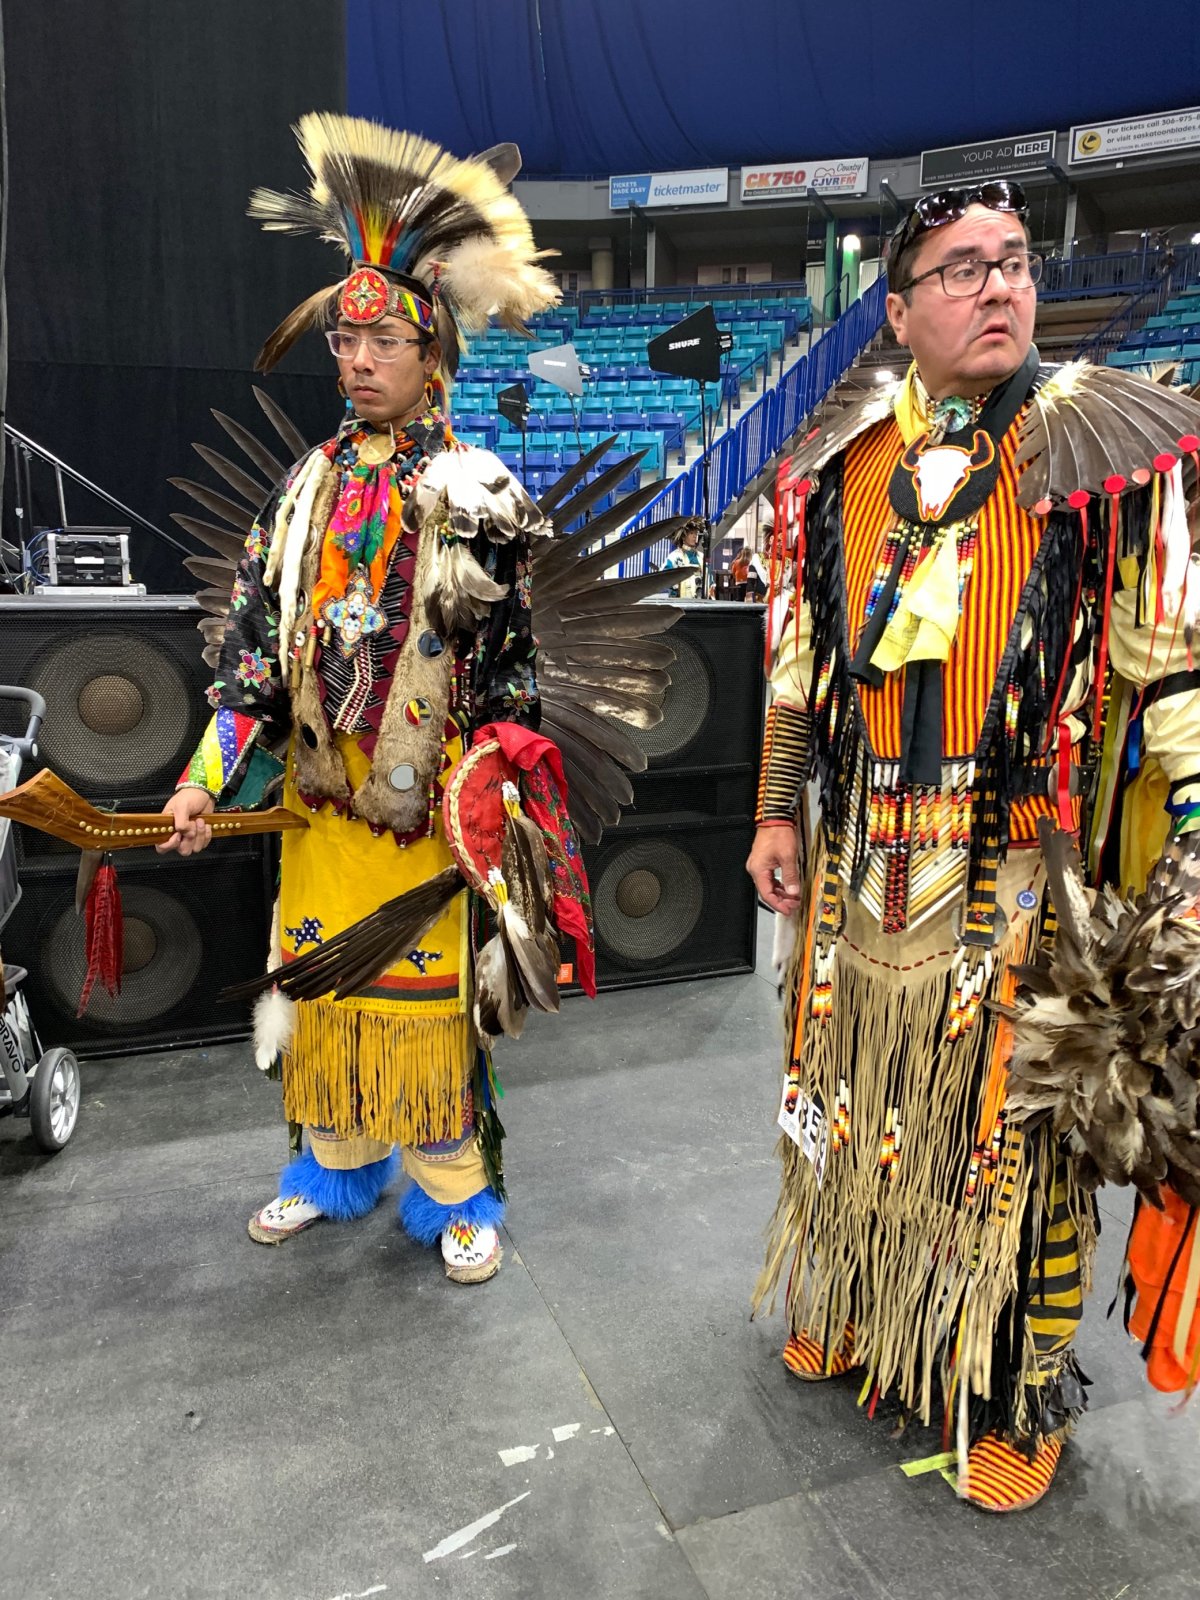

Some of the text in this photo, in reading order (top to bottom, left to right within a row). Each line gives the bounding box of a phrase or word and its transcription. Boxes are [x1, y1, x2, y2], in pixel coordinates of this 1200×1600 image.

[1107, 127, 1119, 135] For
[1120, 123, 1145, 132] tickets
[1147, 119, 1160, 128] call
[1116, 132, 1131, 143] visit
[962, 141, 1049, 163] YOUR AD HERE
[836, 161, 865, 174] Country!
[613, 181, 637, 189] TICKETS
[745, 169, 807, 189] CK750
[630, 186, 646, 194] EASY
[653, 182, 722, 197] ticketmaster
[668, 337, 701, 351] SHURE
[0, 1016, 21, 1073] BRAVO
